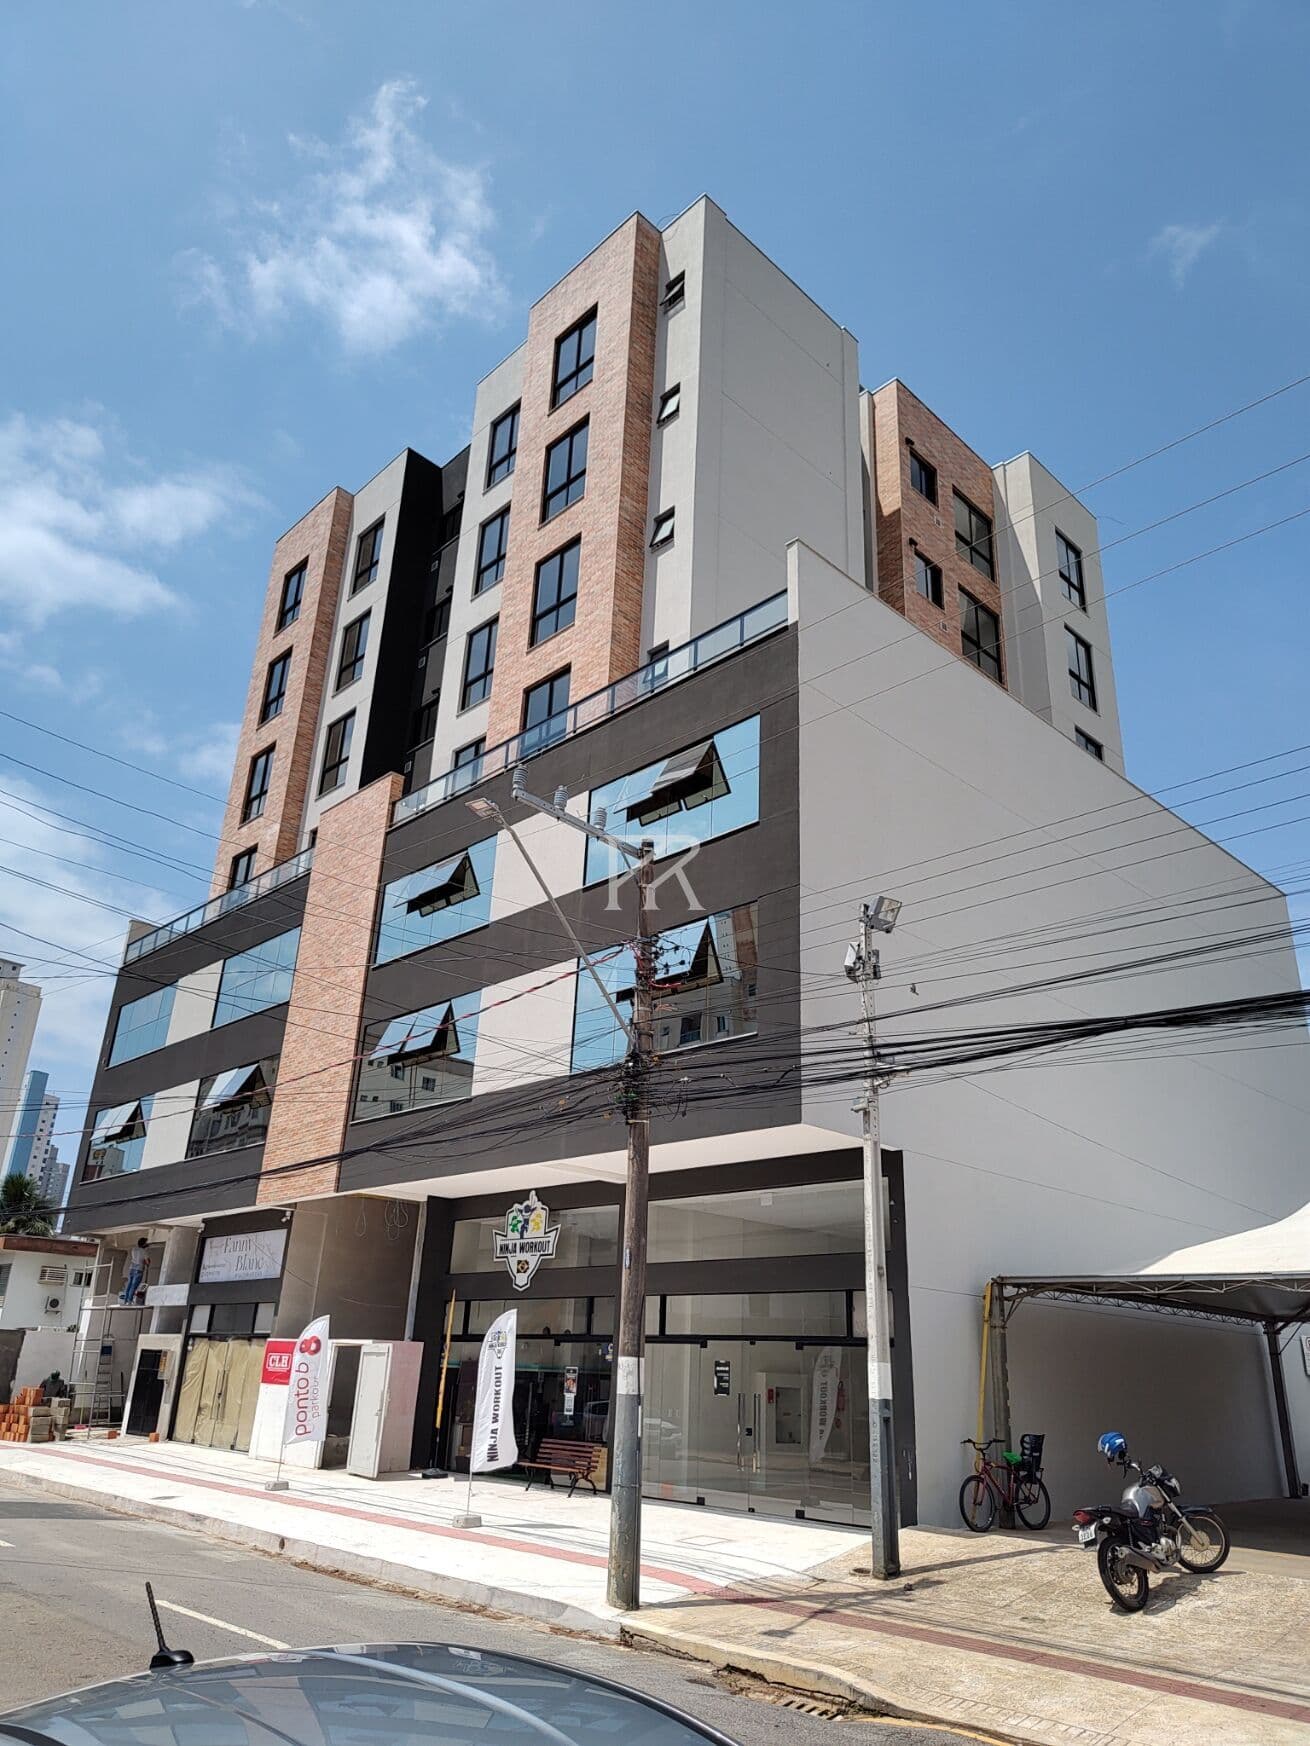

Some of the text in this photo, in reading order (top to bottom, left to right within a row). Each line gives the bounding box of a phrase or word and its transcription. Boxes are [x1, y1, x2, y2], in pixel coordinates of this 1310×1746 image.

[499, 1240, 551, 1255] NINJA WORKOUT
[294, 1377, 311, 1436] ponto
[486, 1365, 503, 1463] NINJA WORKOUT
